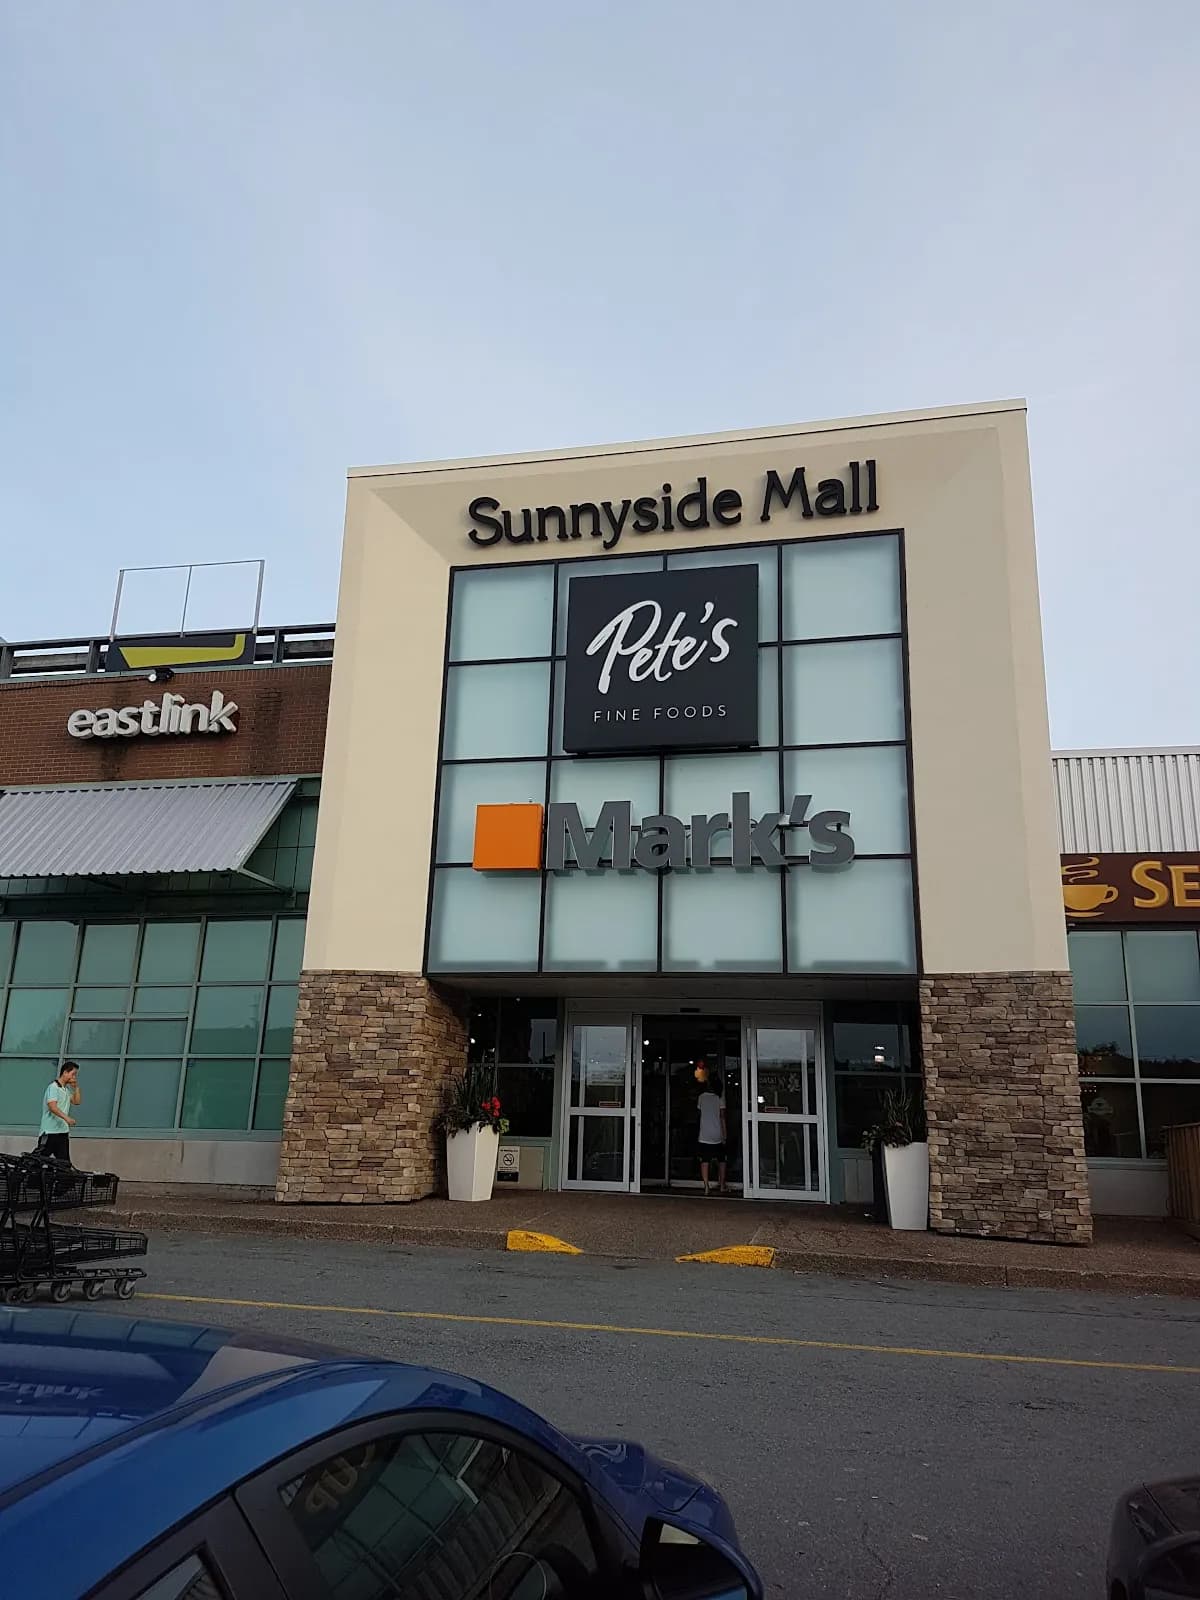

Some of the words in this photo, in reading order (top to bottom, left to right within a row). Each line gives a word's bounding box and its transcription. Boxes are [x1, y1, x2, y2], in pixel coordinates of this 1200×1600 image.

[469, 477, 742, 549] Sunnyside
[761, 460, 879, 522] Mall
[586, 600, 738, 694] Pete's
[68, 690, 238, 738] eastlink
[594, 709, 641, 723] FINE
[654, 705, 728, 720] FOODS
[547, 792, 856, 870] Mark's
[1132, 860, 1200, 908] SE
